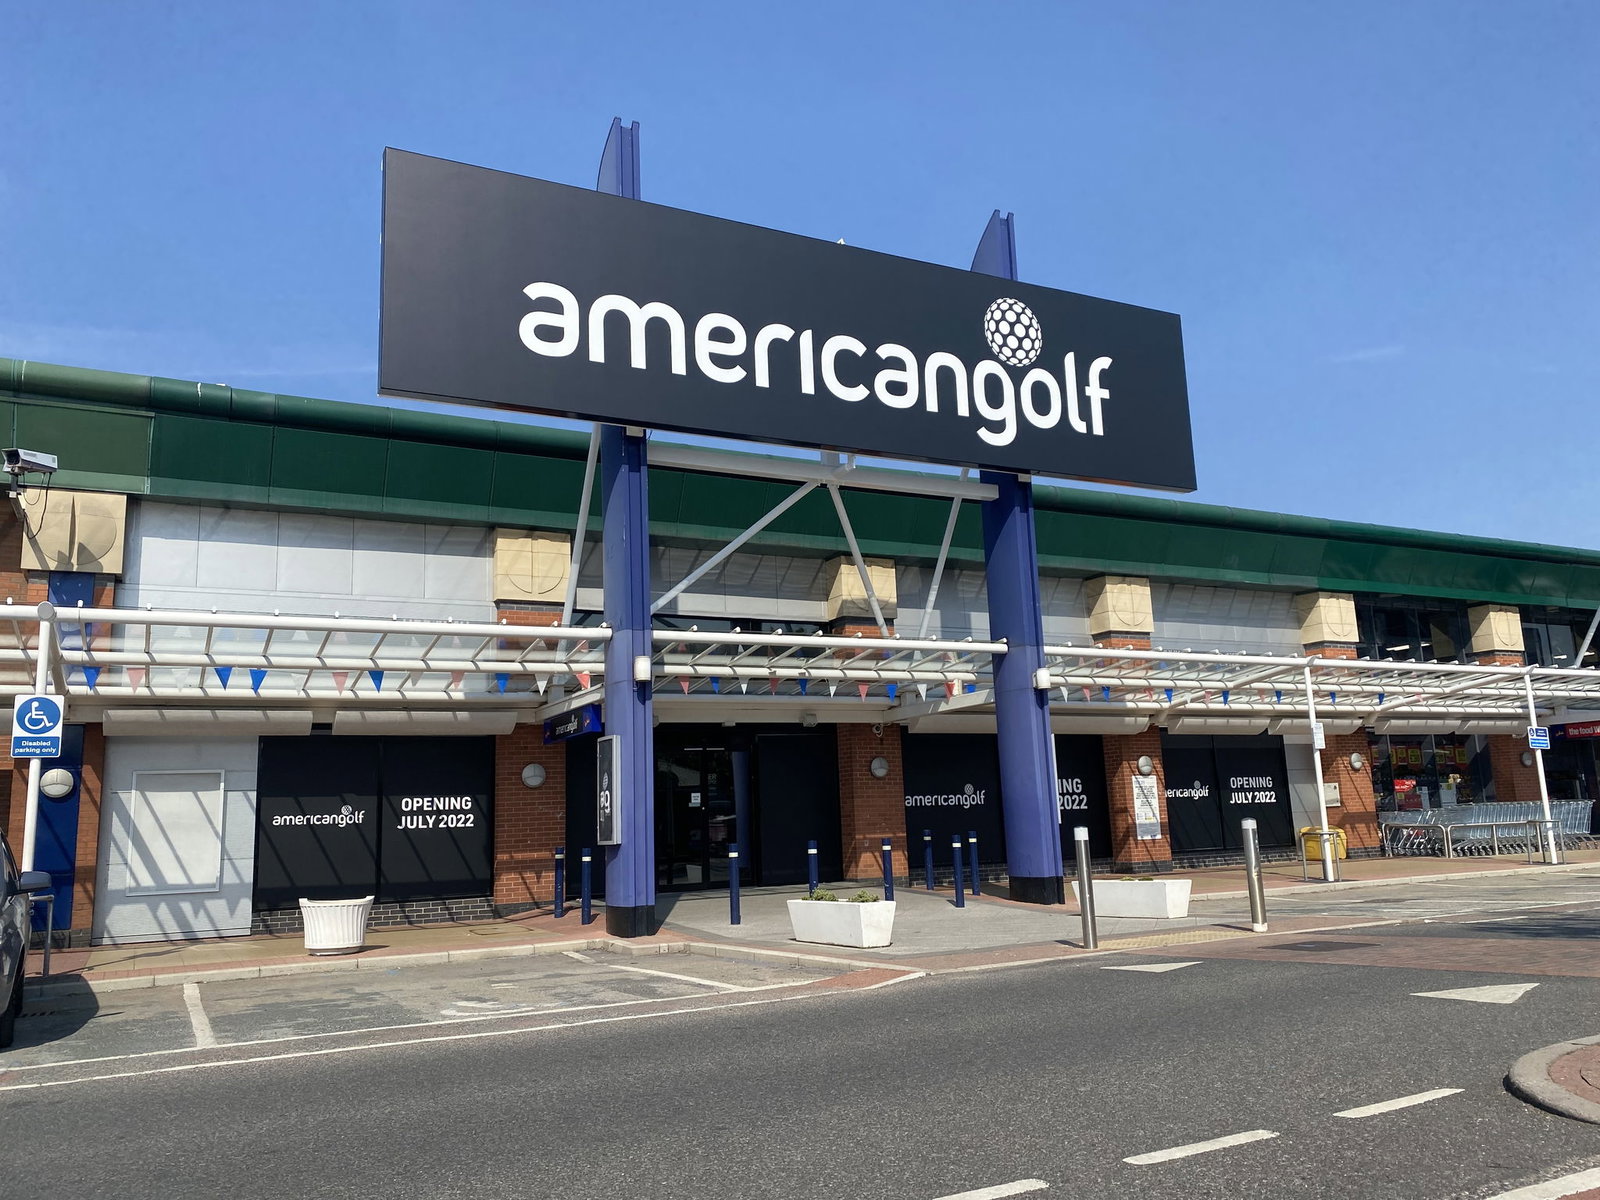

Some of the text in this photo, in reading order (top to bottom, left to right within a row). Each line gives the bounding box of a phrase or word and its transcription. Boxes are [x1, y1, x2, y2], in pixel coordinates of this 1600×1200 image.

[518, 281, 1113, 447] americangolf
[1230, 776, 1273, 789] OPENING
[904, 789, 986, 809] americangolf
[1164, 785, 1210, 800] ericangolf
[1230, 791, 1277, 804] JULY 2022
[401, 796, 472, 811] OPENING
[1058, 794, 1088, 810] 2022
[271, 809, 366, 828] americangolf
[396, 813, 475, 829] JULY 2022
